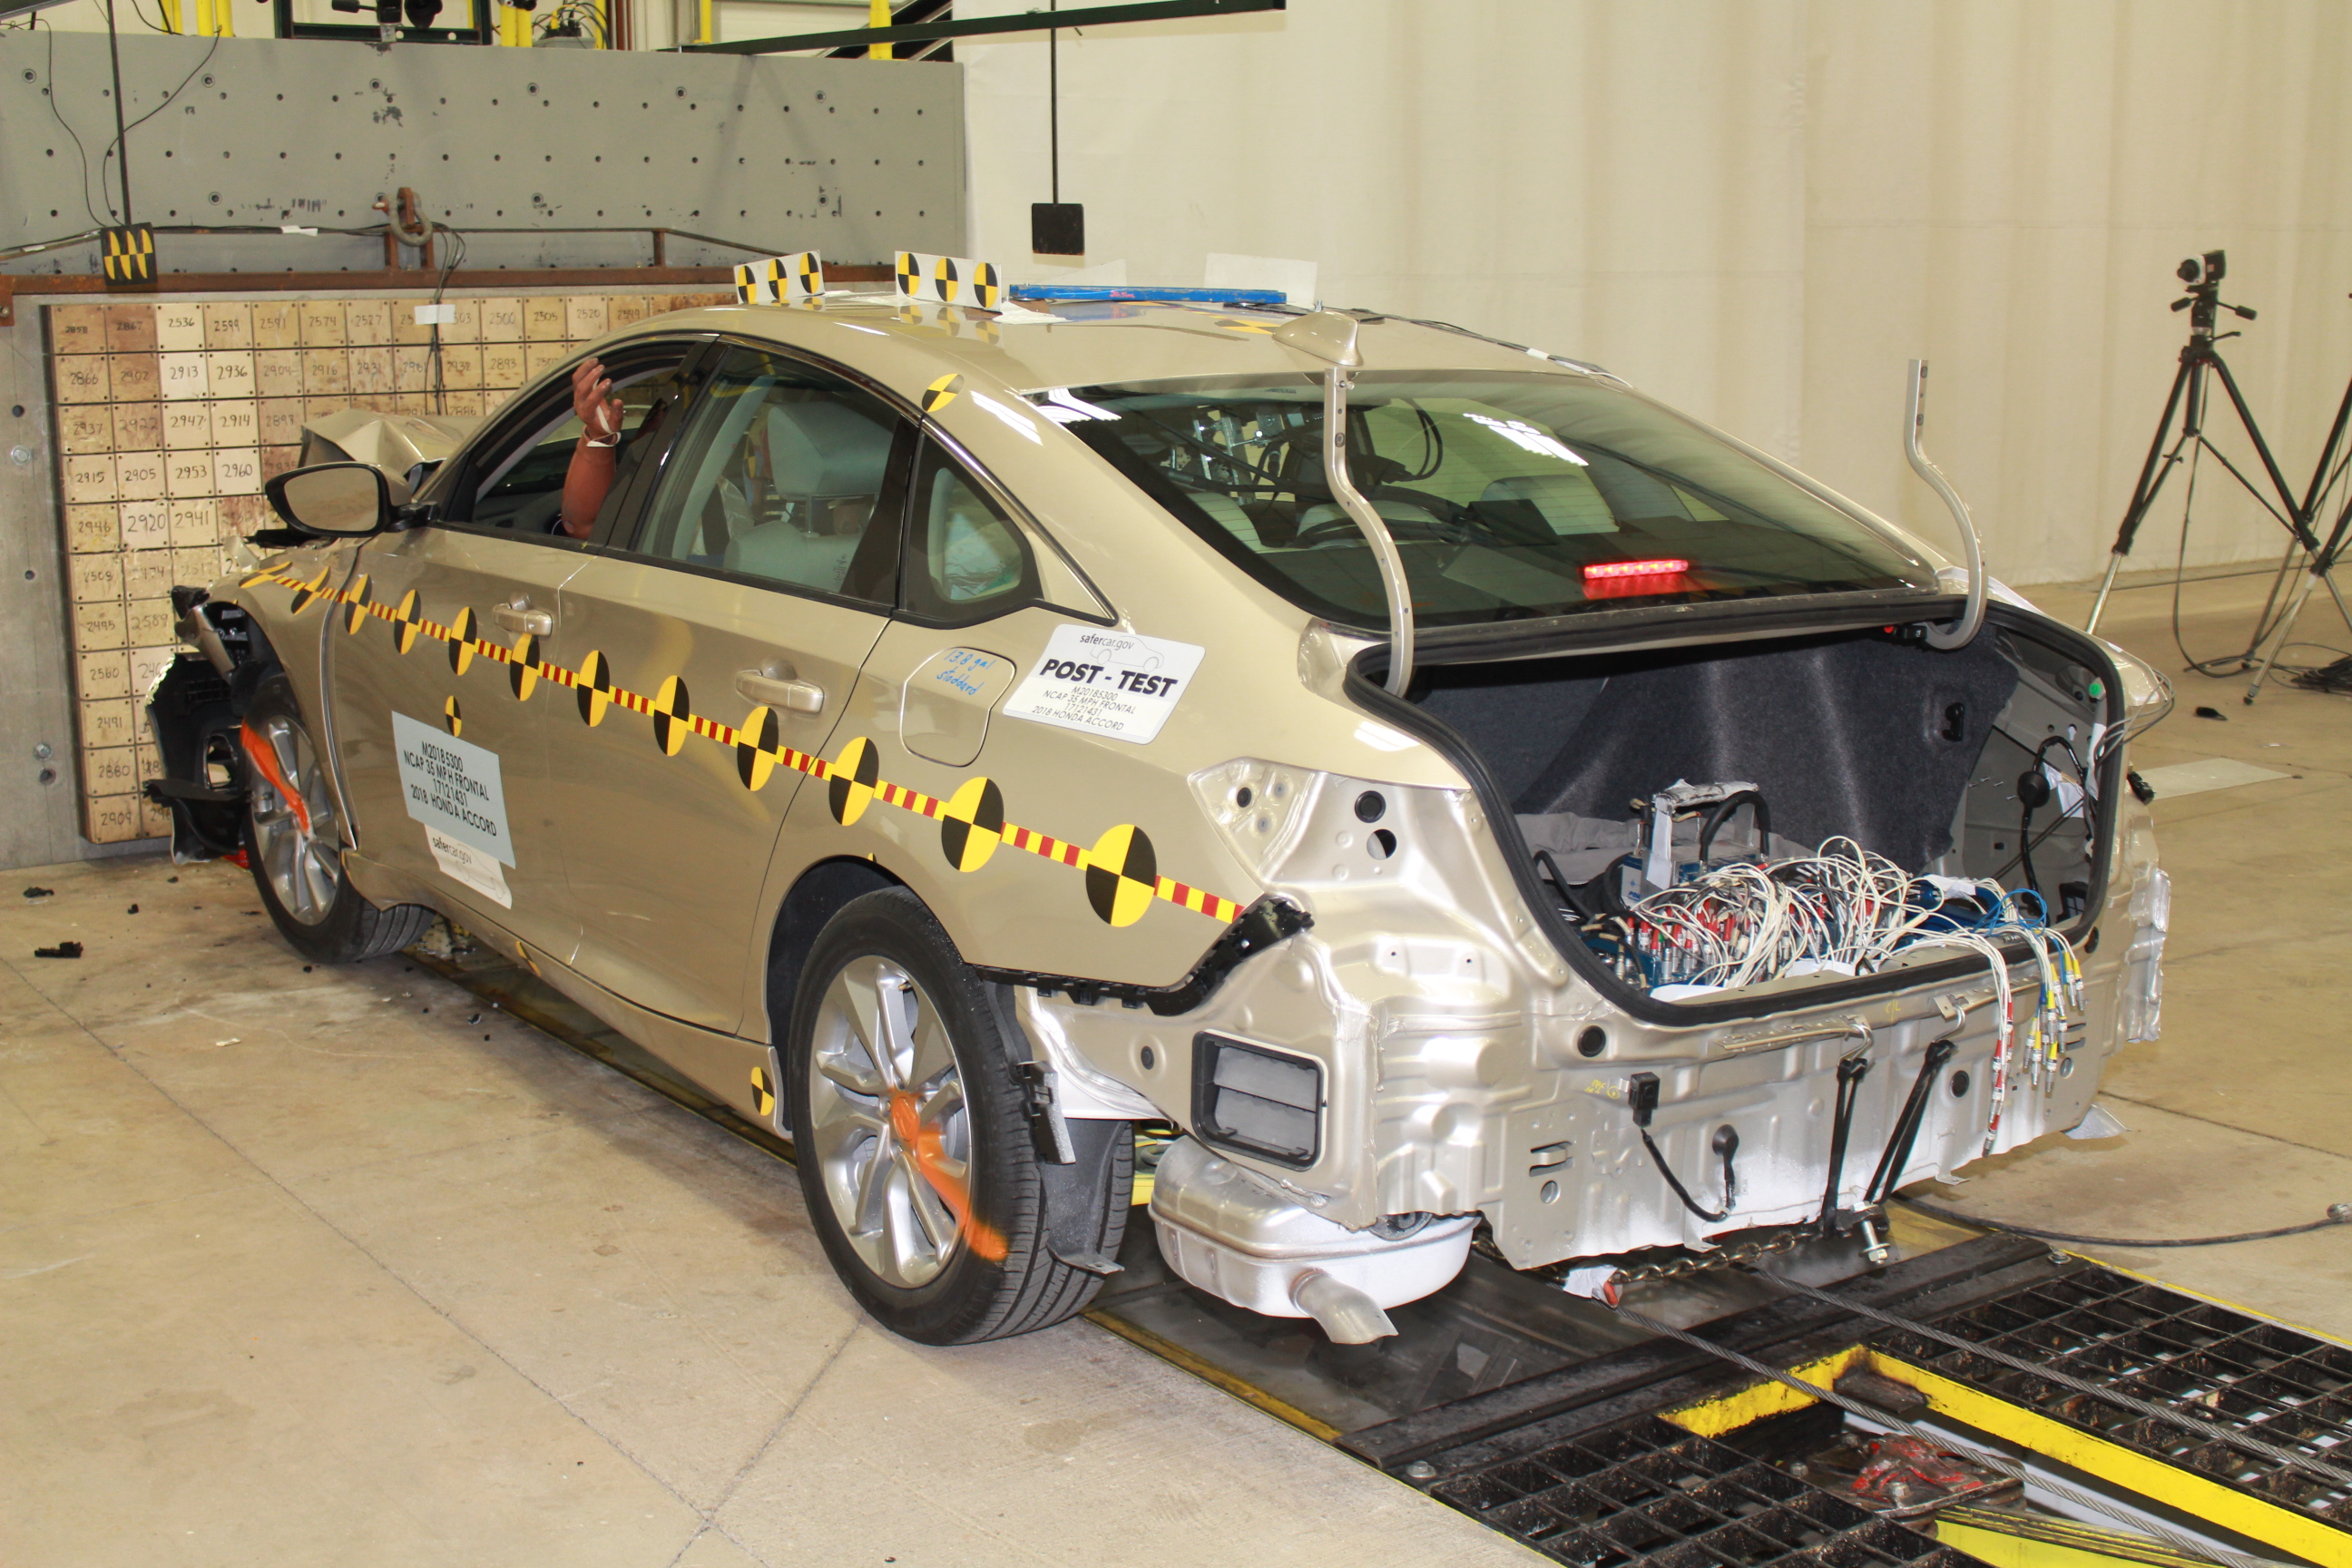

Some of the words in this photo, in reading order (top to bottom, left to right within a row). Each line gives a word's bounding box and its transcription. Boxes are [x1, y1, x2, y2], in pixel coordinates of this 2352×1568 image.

[355, 314, 383, 326] 2527
[399, 313, 415, 325] 25
[489, 312, 516, 325] 2500
[534, 311, 558, 322] 2505
[576, 309, 601, 318] 2520
[168, 318, 195, 328] 2536
[214, 318, 240, 332] 2599
[260, 318, 287, 329] 2591
[309, 315, 337, 327] 2574
[312, 366, 338, 376] 2916
[489, 358, 517, 370] 2893
[70, 372, 99, 386] 2866
[121, 370, 149, 381] 2902
[170, 366, 199, 380] 2913
[217, 366, 248, 380] 2936
[119, 417, 158, 432] 2922
[171, 415, 203, 427] 2947
[220, 415, 250, 426] 2914
[74, 422, 103, 436] 2937
[76, 471, 105, 483] 2915
[125, 468, 157, 482] 2905
[175, 466, 208, 479] 2953
[223, 464, 252, 477] 2960
[78, 521, 111, 533] 2946
[127, 514, 167, 532] 2920
[174, 511, 210, 529] 2941
[86, 620, 115, 632] 2495
[131, 614, 169, 632] 2589
[1080, 633, 1134, 651] safercar.gov
[944, 649, 969, 665] 13.8
[967, 657, 995, 671] gal
[1040, 658, 1103, 682] POST
[1117, 670, 1178, 698] TEST
[1072, 685, 1117, 701] M20185300
[1044, 690, 1067, 702] NCAP
[1067, 693, 1078, 703] 35
[1079, 697, 1098, 707] MPH
[1099, 700, 1135, 715] FRONTAL
[1064, 702, 1102, 717] 17121431
[97, 718, 122, 729] 2491
[1032, 705, 1051, 716] 2018
[1052, 708, 1083, 723] HONDA
[1085, 714, 1124, 730] ACCORD
[98, 765, 130, 778] 2880
[404, 750, 424, 771] NCAP
[426, 761, 436, 776] 35
[436, 765, 455, 784] MPH
[456, 773, 489, 801] FRONTAL
[433, 778, 468, 808] 17121431
[410, 784, 428, 804] 2018
[432, 793, 461, 819] HONDA
[462, 809, 497, 837] ACCORD
[101, 813, 132, 827] 2909
[432, 837, 473, 865] safercar.gov
